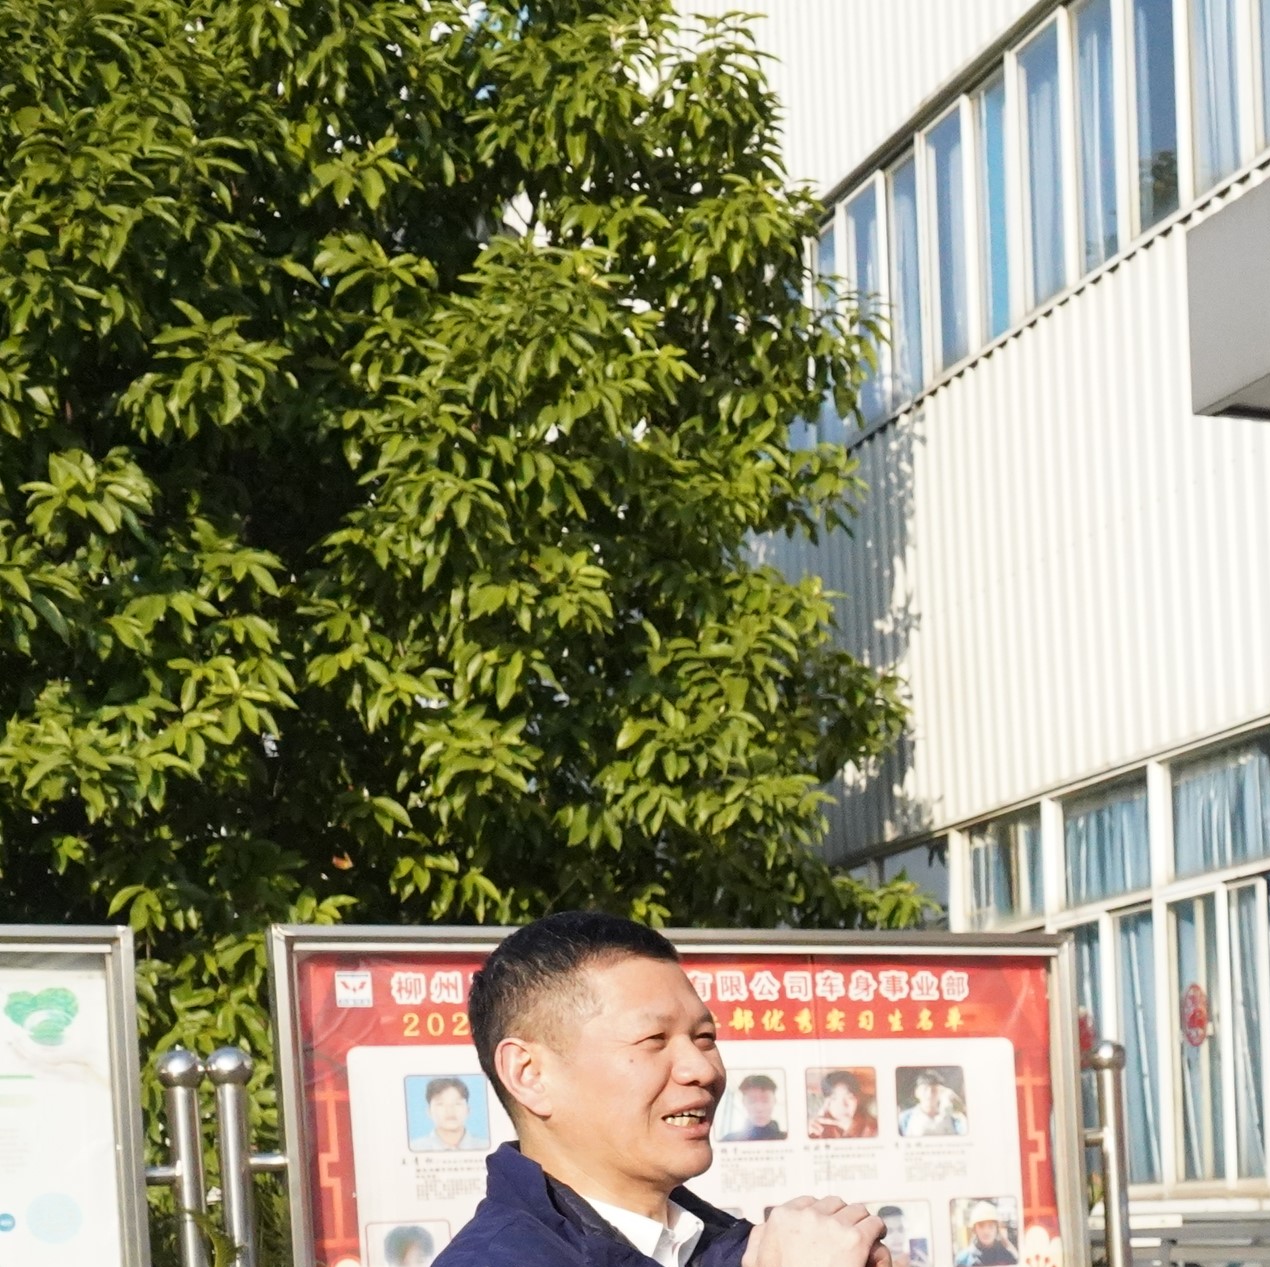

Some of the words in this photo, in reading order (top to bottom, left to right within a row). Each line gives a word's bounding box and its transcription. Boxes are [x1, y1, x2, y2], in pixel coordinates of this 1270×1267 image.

[391, 971, 464, 1004] 柳州
[688, 970, 968, 1002] 有限公司车身事业部
[713, 1006, 964, 1034] 部优秀实习生名单
